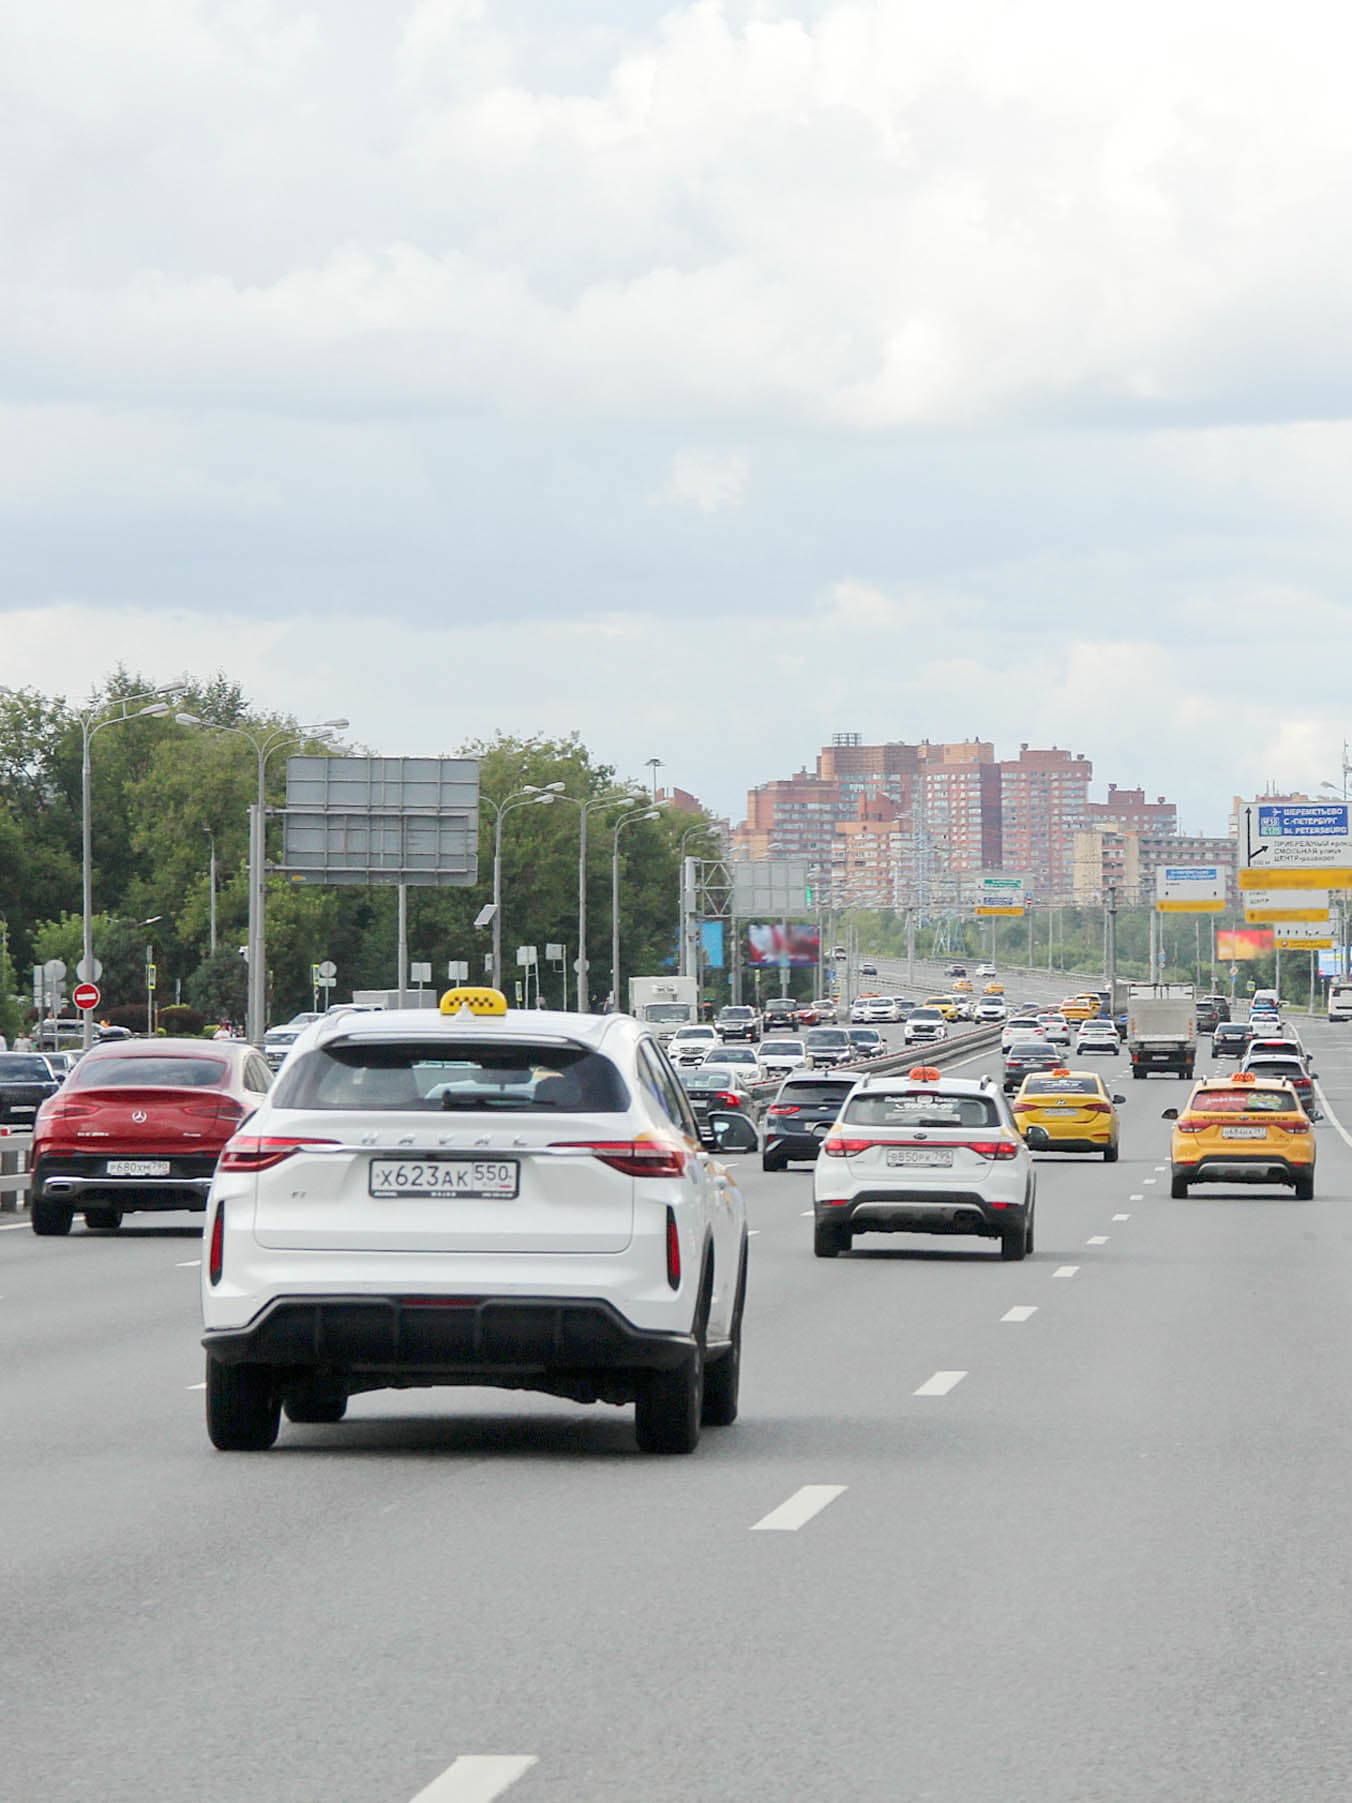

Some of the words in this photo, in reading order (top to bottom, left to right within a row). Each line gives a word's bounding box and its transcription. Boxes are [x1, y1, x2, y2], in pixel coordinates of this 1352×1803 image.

[361, 1131, 528, 1146] HAVAL
[380, 1164, 468, 1187] Х623АК
[474, 1164, 509, 1181] 550
